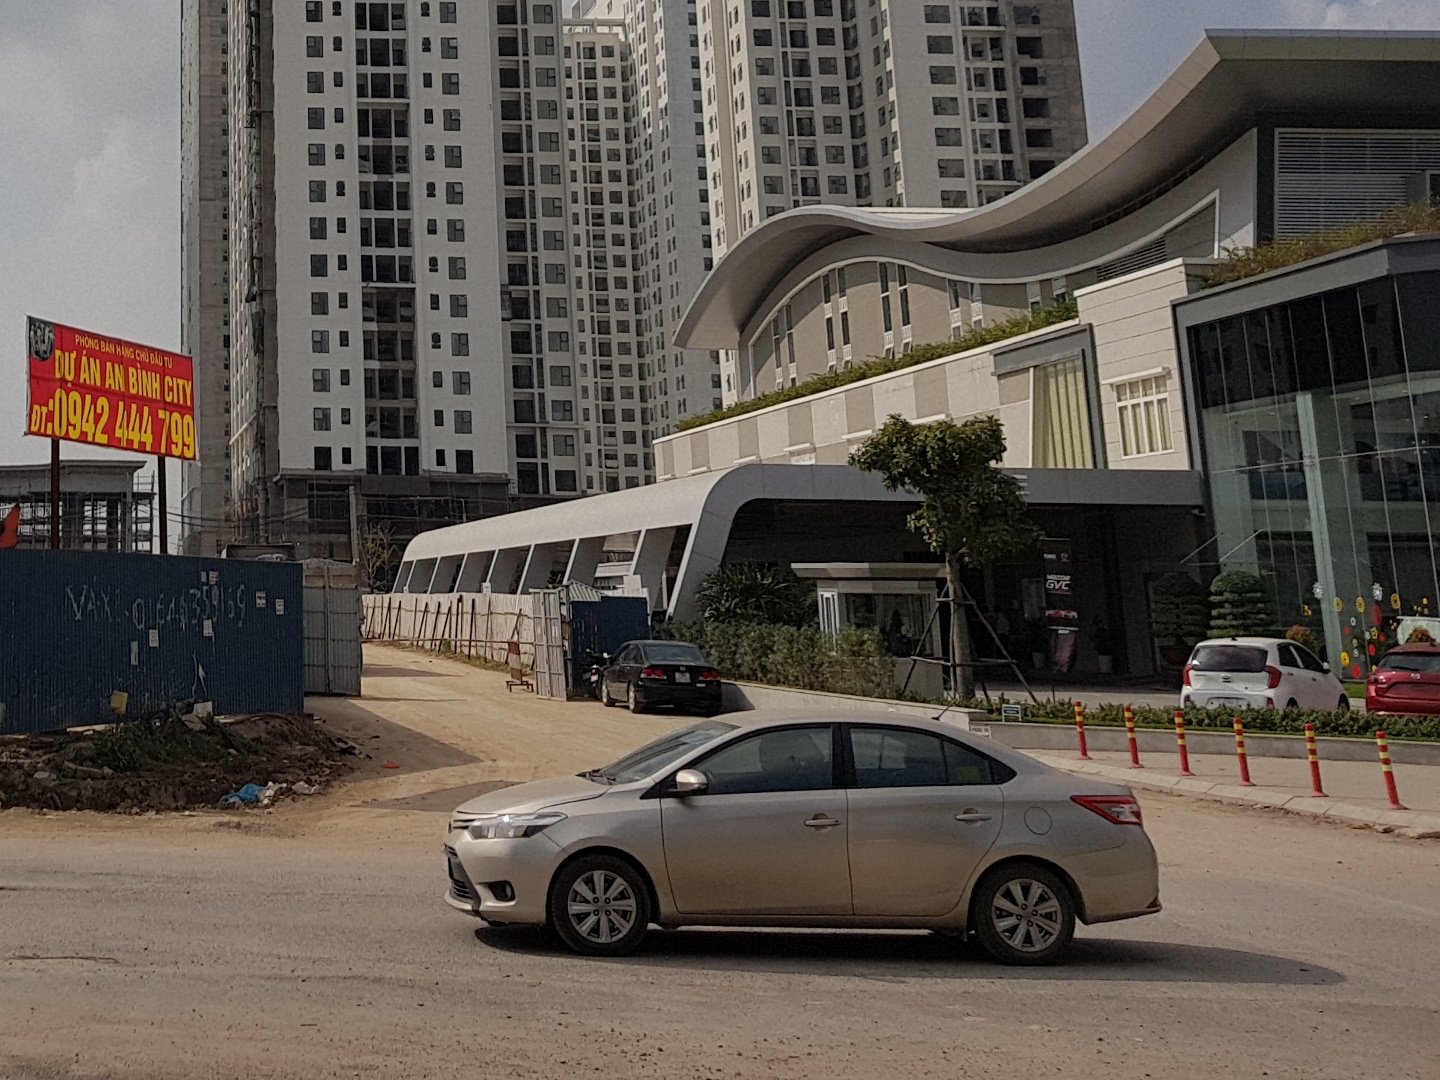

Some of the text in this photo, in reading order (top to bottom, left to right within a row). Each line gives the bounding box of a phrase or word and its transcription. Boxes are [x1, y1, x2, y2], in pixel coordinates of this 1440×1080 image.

[55, 349, 192, 406] DỰ ÁN AN BÌNH CITY
[115, 400, 153, 451] 444
[158, 409, 196, 458] 799
[1046, 580, 1071, 590] GVC
